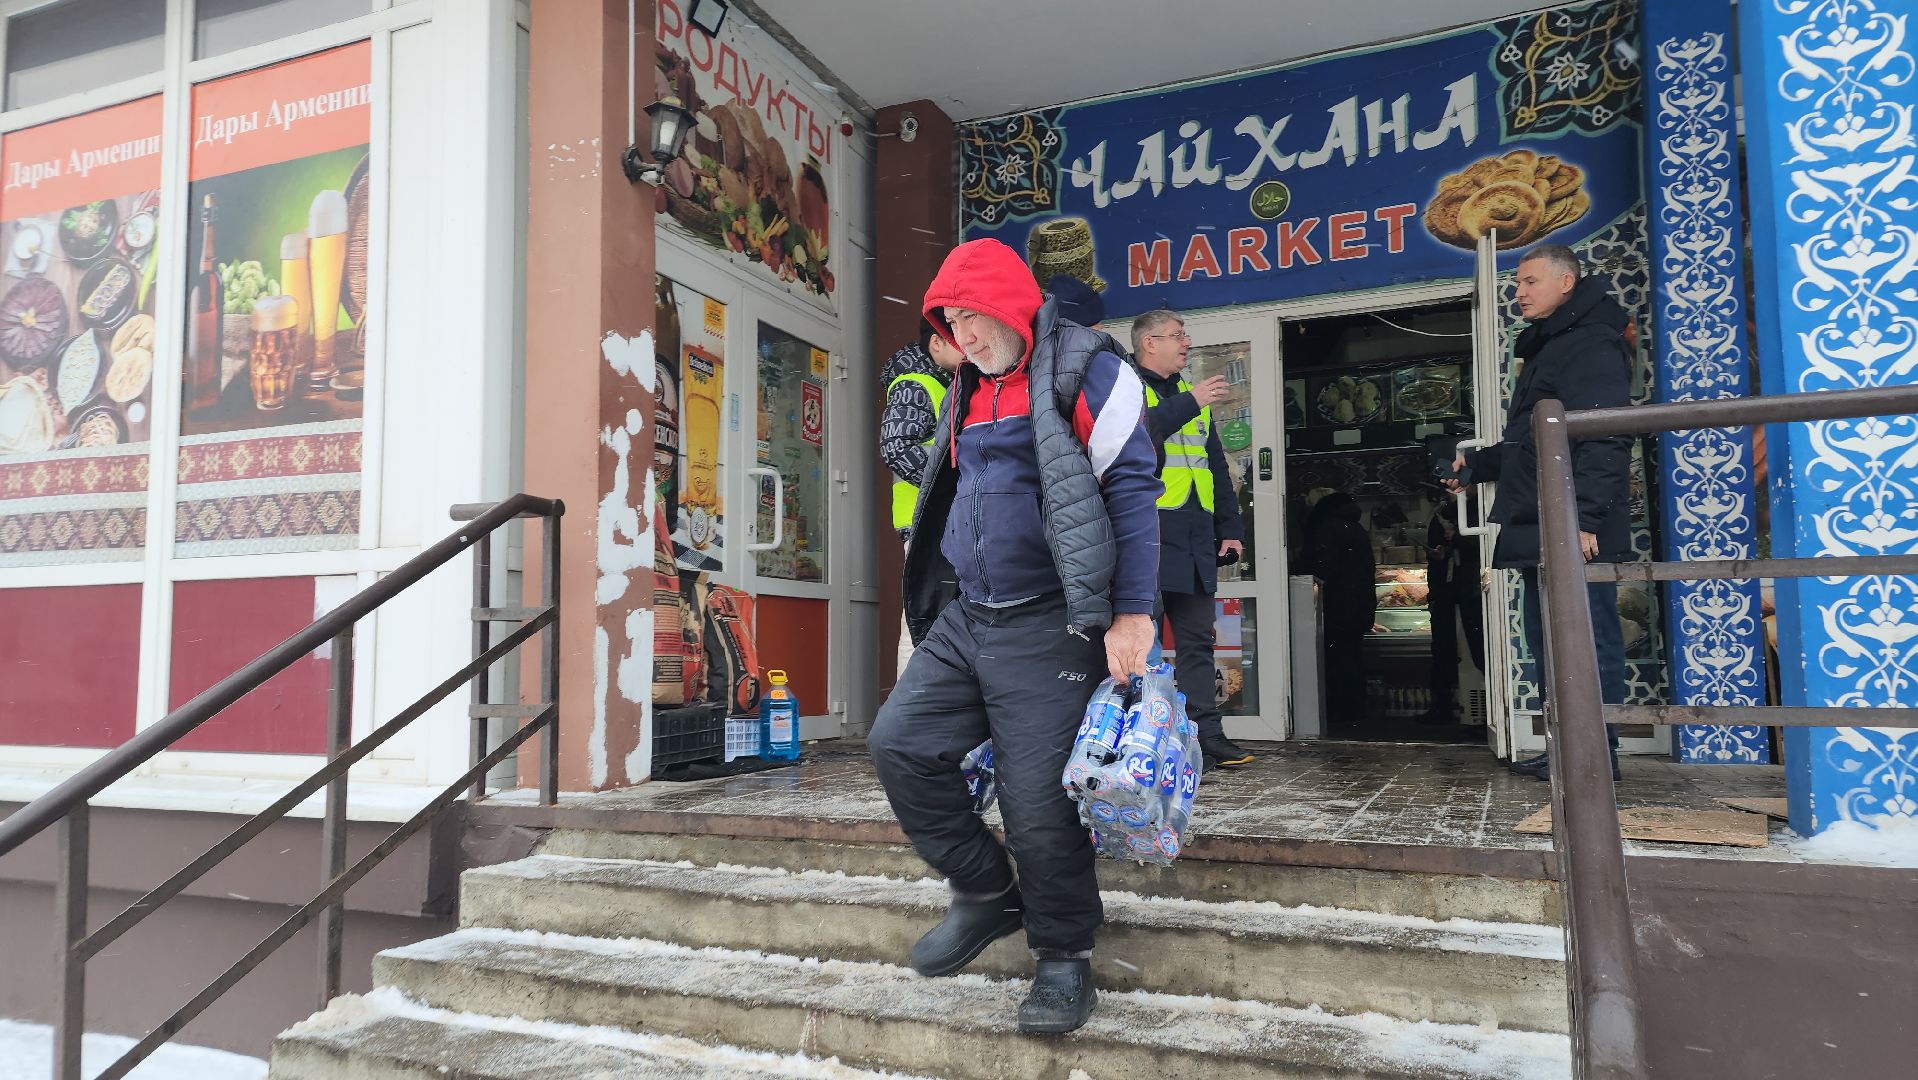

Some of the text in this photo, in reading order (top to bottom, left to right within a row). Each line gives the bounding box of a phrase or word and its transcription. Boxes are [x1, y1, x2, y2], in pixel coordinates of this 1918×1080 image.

[194, 84, 371, 149] Дары Армении
[5, 135, 161, 191] Дары Армении
[1127, 203, 1417, 288] MARKET
[1128, 757, 1154, 776] RC
